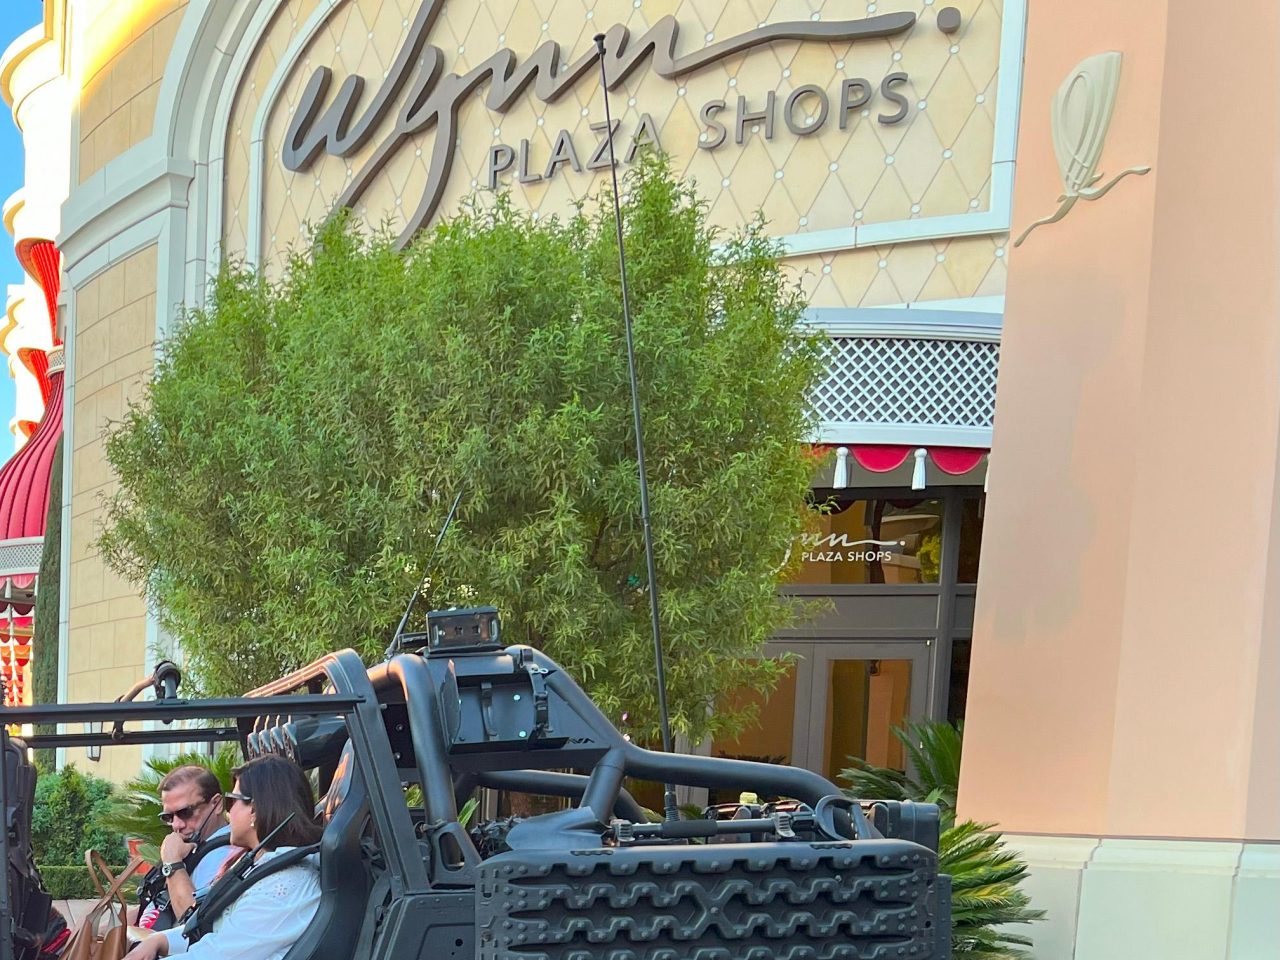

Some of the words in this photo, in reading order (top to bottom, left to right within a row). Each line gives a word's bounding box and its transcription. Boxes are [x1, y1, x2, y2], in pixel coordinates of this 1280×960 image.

[488, 112, 663, 190] PLAZA
[698, 72, 911, 151] SHOPS
[801, 551, 844, 563] PLAZA
[847, 551, 892, 563] SHOPS
